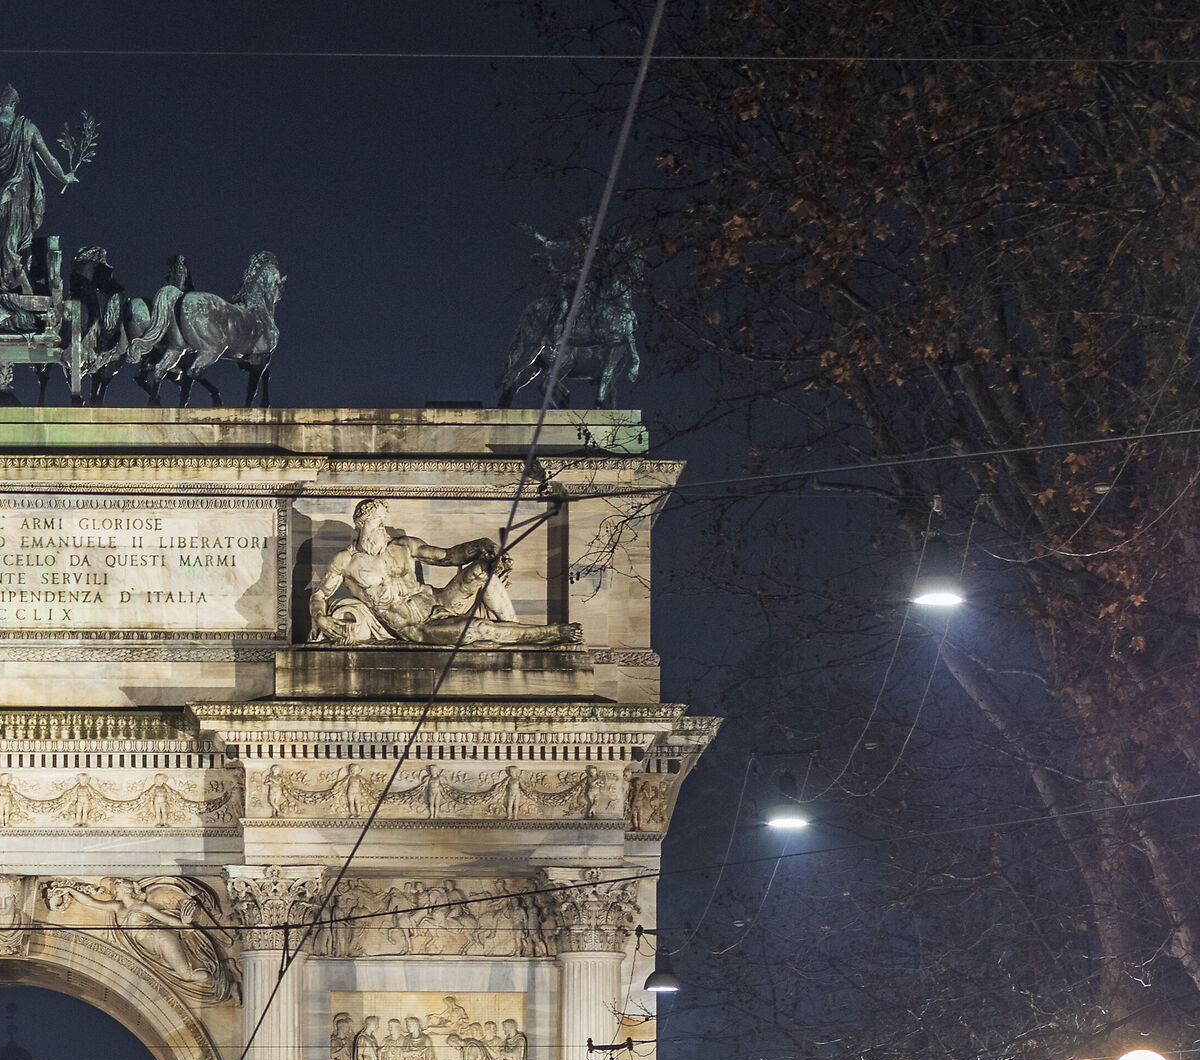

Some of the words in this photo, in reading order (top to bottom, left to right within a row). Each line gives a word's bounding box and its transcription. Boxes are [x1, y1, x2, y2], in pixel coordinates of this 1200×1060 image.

[20, 517, 63, 531] ARMI
[78, 517, 163, 531] GLORIOSE
[20, 536, 117, 549] EMANUELE
[132, 536, 144, 548] II
[159, 536, 268, 549] LIBERATORI
[69, 554, 91, 567] DA
[104, 554, 166, 568] QUESTI
[179, 554, 237, 567] MARMI
[40, 572, 109, 585] SERVILI
[147, 591, 208, 604] ITALIA
